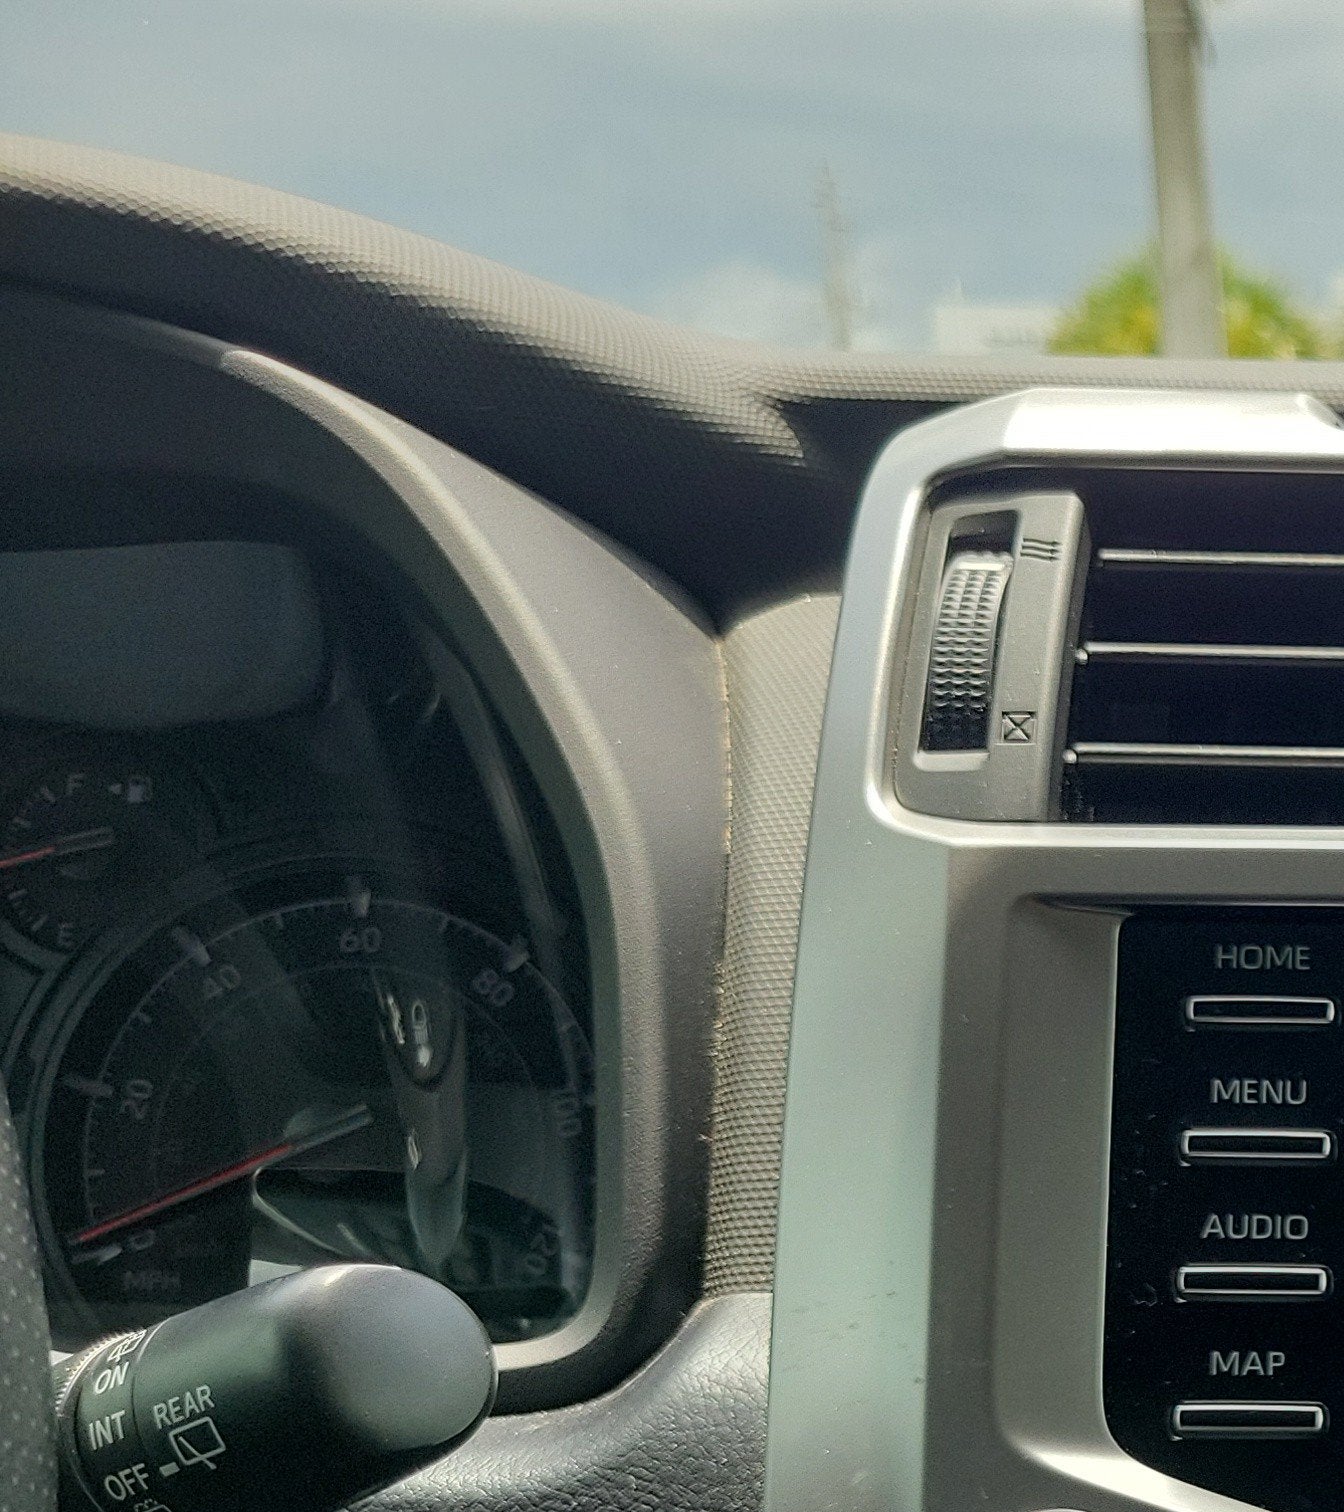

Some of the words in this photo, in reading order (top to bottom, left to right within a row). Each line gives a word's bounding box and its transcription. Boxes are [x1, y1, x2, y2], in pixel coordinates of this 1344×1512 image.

[338, 927, 382, 953] 60
[1215, 945, 1311, 970] HOME
[201, 963, 242, 1001] 40
[471, 970, 514, 1008] 80
[1210, 1079, 1307, 1104] MENU
[1202, 1214, 1309, 1240] AUDIO
[93, 1363, 128, 1395] ON
[1210, 1350, 1285, 1376] MAP
[152, 1384, 215, 1430] REAR
[88, 1411, 126, 1451] INT
[103, 1462, 150, 1501] OFF
